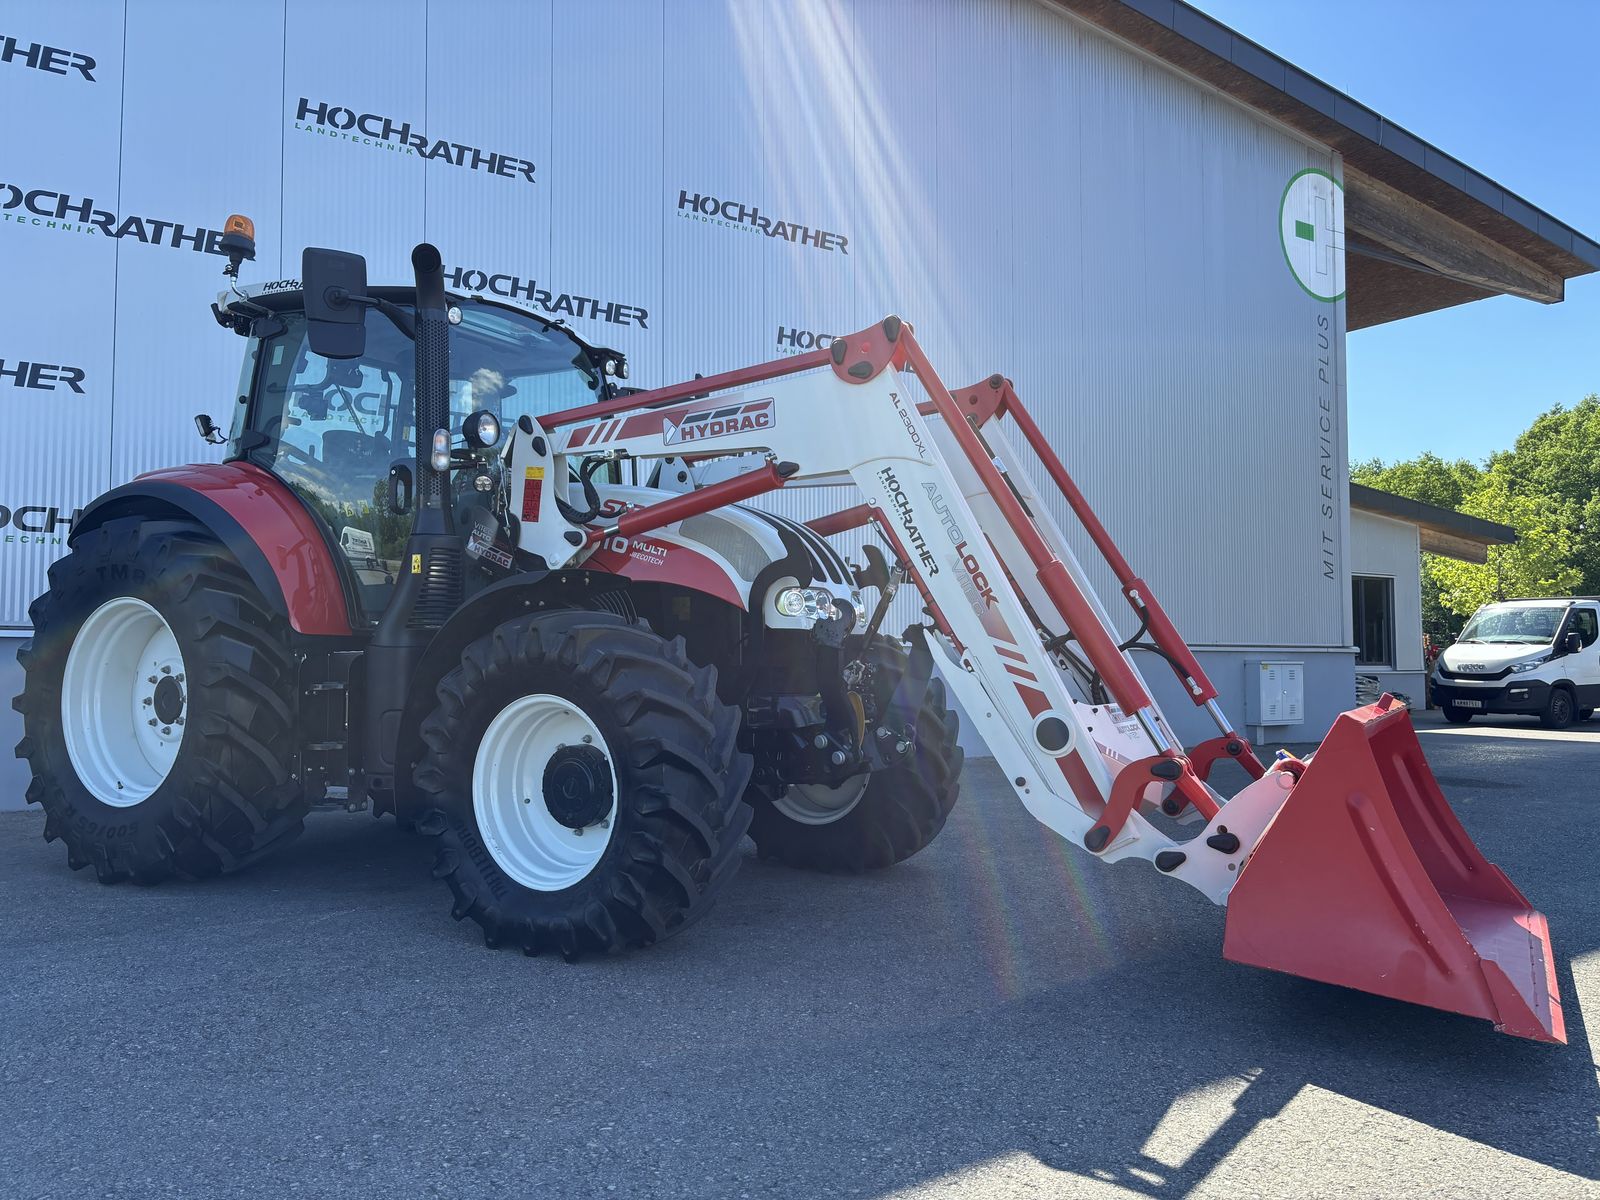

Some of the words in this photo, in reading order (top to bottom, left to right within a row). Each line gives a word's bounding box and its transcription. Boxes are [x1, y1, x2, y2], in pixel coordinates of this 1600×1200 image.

[0, 35, 97, 83] HER
[295, 122, 413, 155] LANDTECHNIK
[296, 97, 536, 183] HOCHRATHER
[676, 211, 761, 235] LANDTECHNIK
[677, 190, 849, 255] HOCHRATHER
[1318, 315, 1330, 386] PLUS
[681, 412, 770, 441] HYDRAC
[888, 392, 900, 409] AL
[899, 408, 927, 459] 2300XL
[1319, 397, 1333, 520] SERVICE
[471, 529, 492, 541] AUTO
[881, 467, 940, 578] HOCHRATHER
[921, 482, 1000, 610] AUTOLOCK
[474, 544, 510, 567] HYDRAC
[632, 540, 668, 557] MULTI
[1322, 531, 1335, 580] MIT
